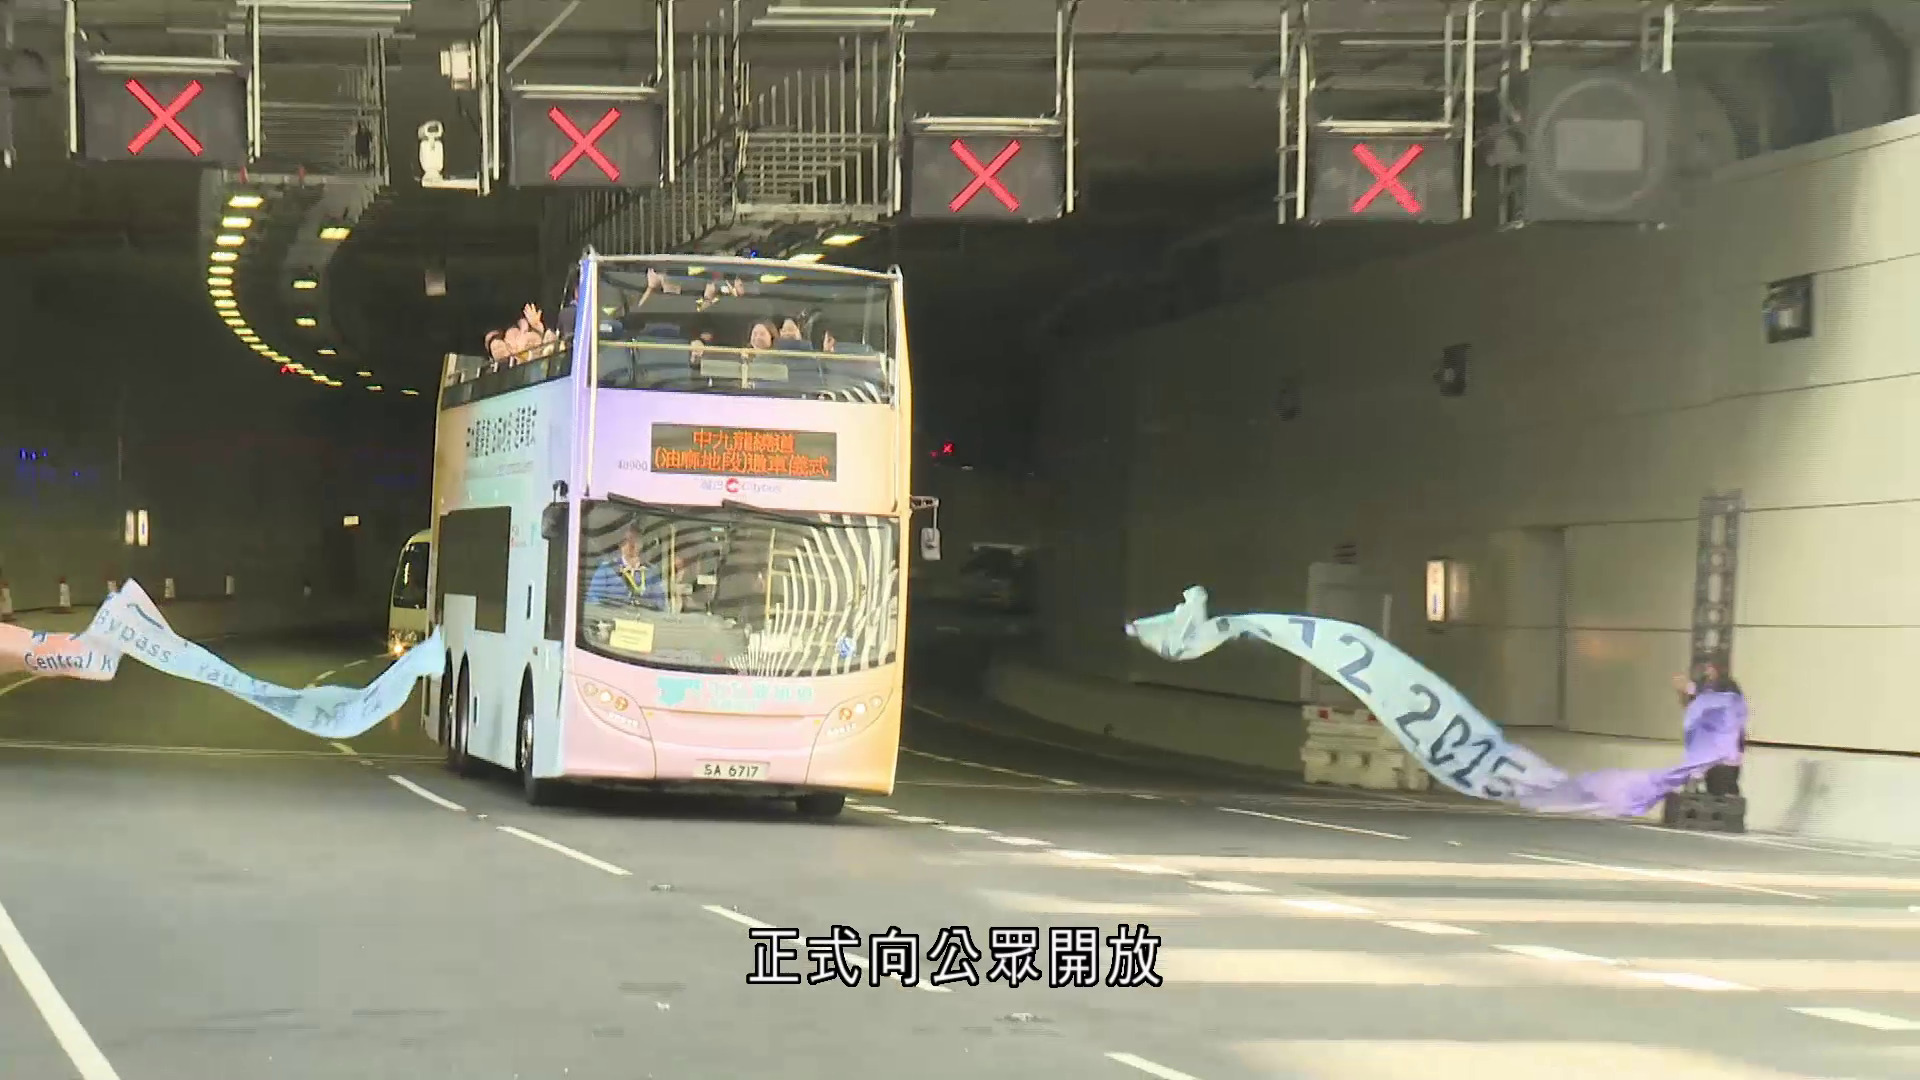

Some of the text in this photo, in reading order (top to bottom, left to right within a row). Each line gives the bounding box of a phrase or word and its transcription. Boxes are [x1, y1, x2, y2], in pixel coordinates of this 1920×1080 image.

[25, 651, 93, 672] Central
[96, 608, 172, 663] Bypass
[728, 765, 759, 777] 6717
